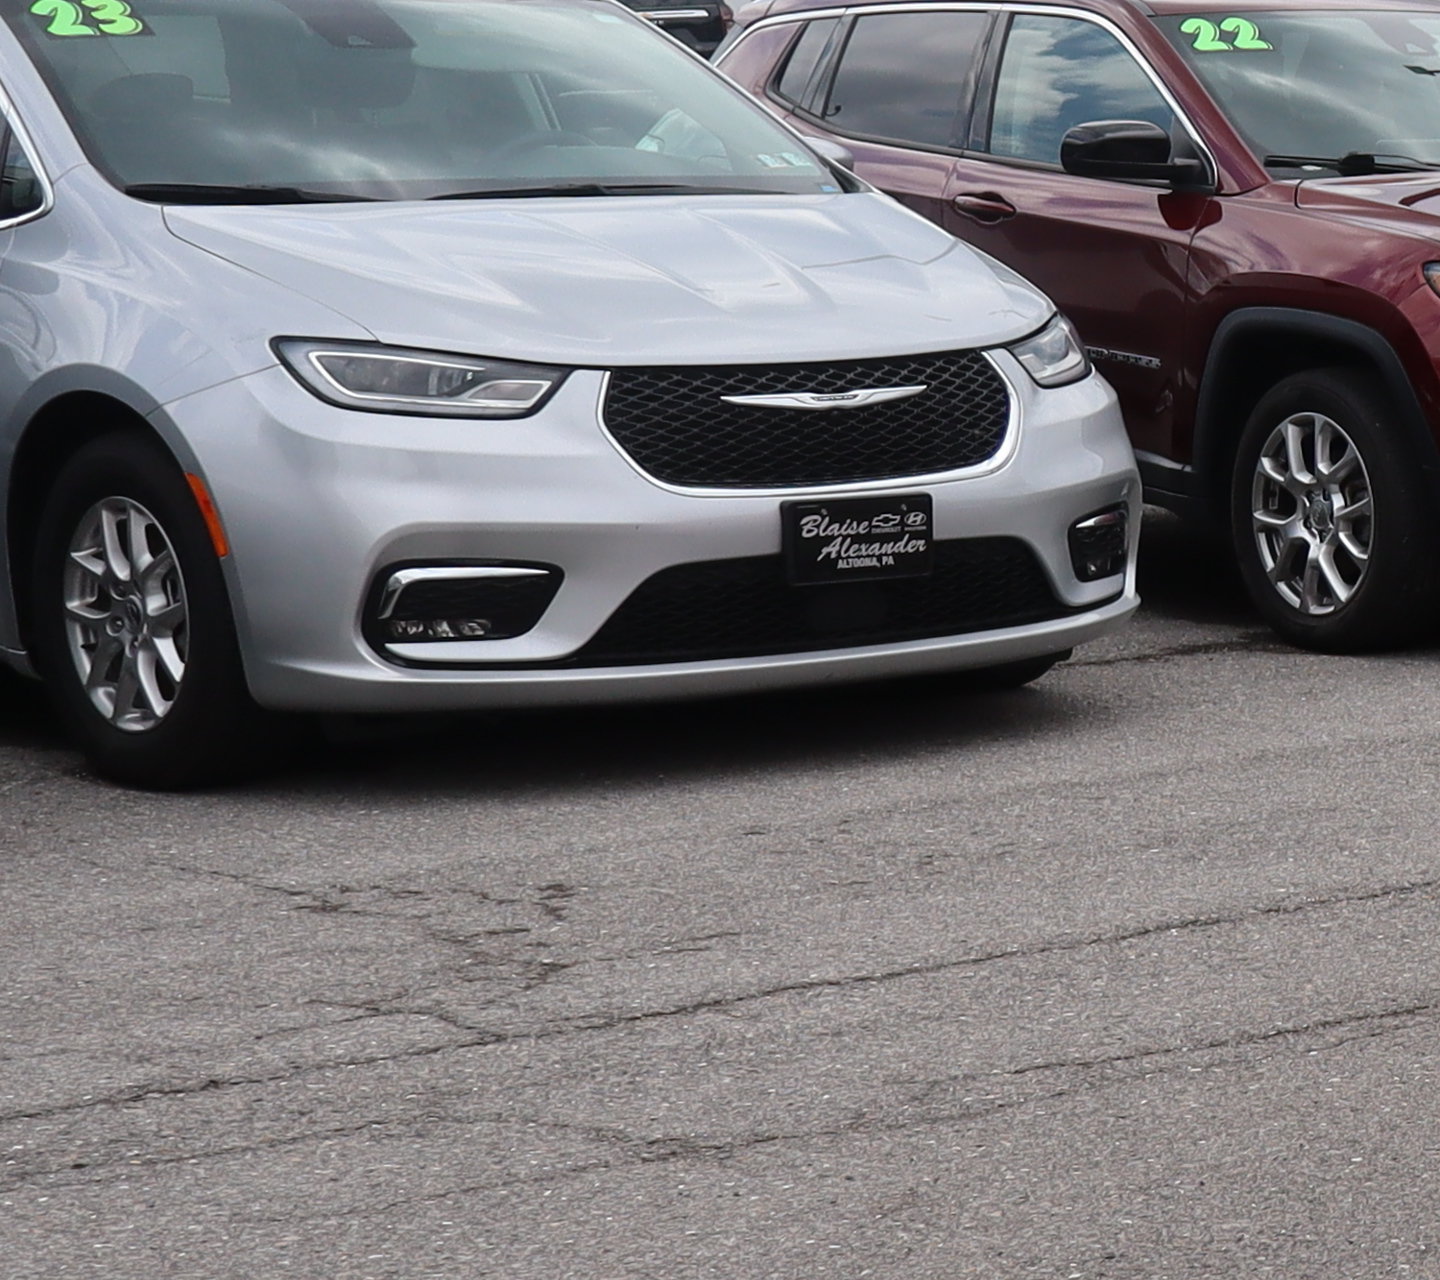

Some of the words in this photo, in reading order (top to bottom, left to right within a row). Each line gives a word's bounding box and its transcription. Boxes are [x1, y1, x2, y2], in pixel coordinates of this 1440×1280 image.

[1180, 17, 1273, 52] 22
[800, 515, 870, 538] Blaise
[817, 534, 927, 561] Alexander
[882, 555, 895, 566] PA
